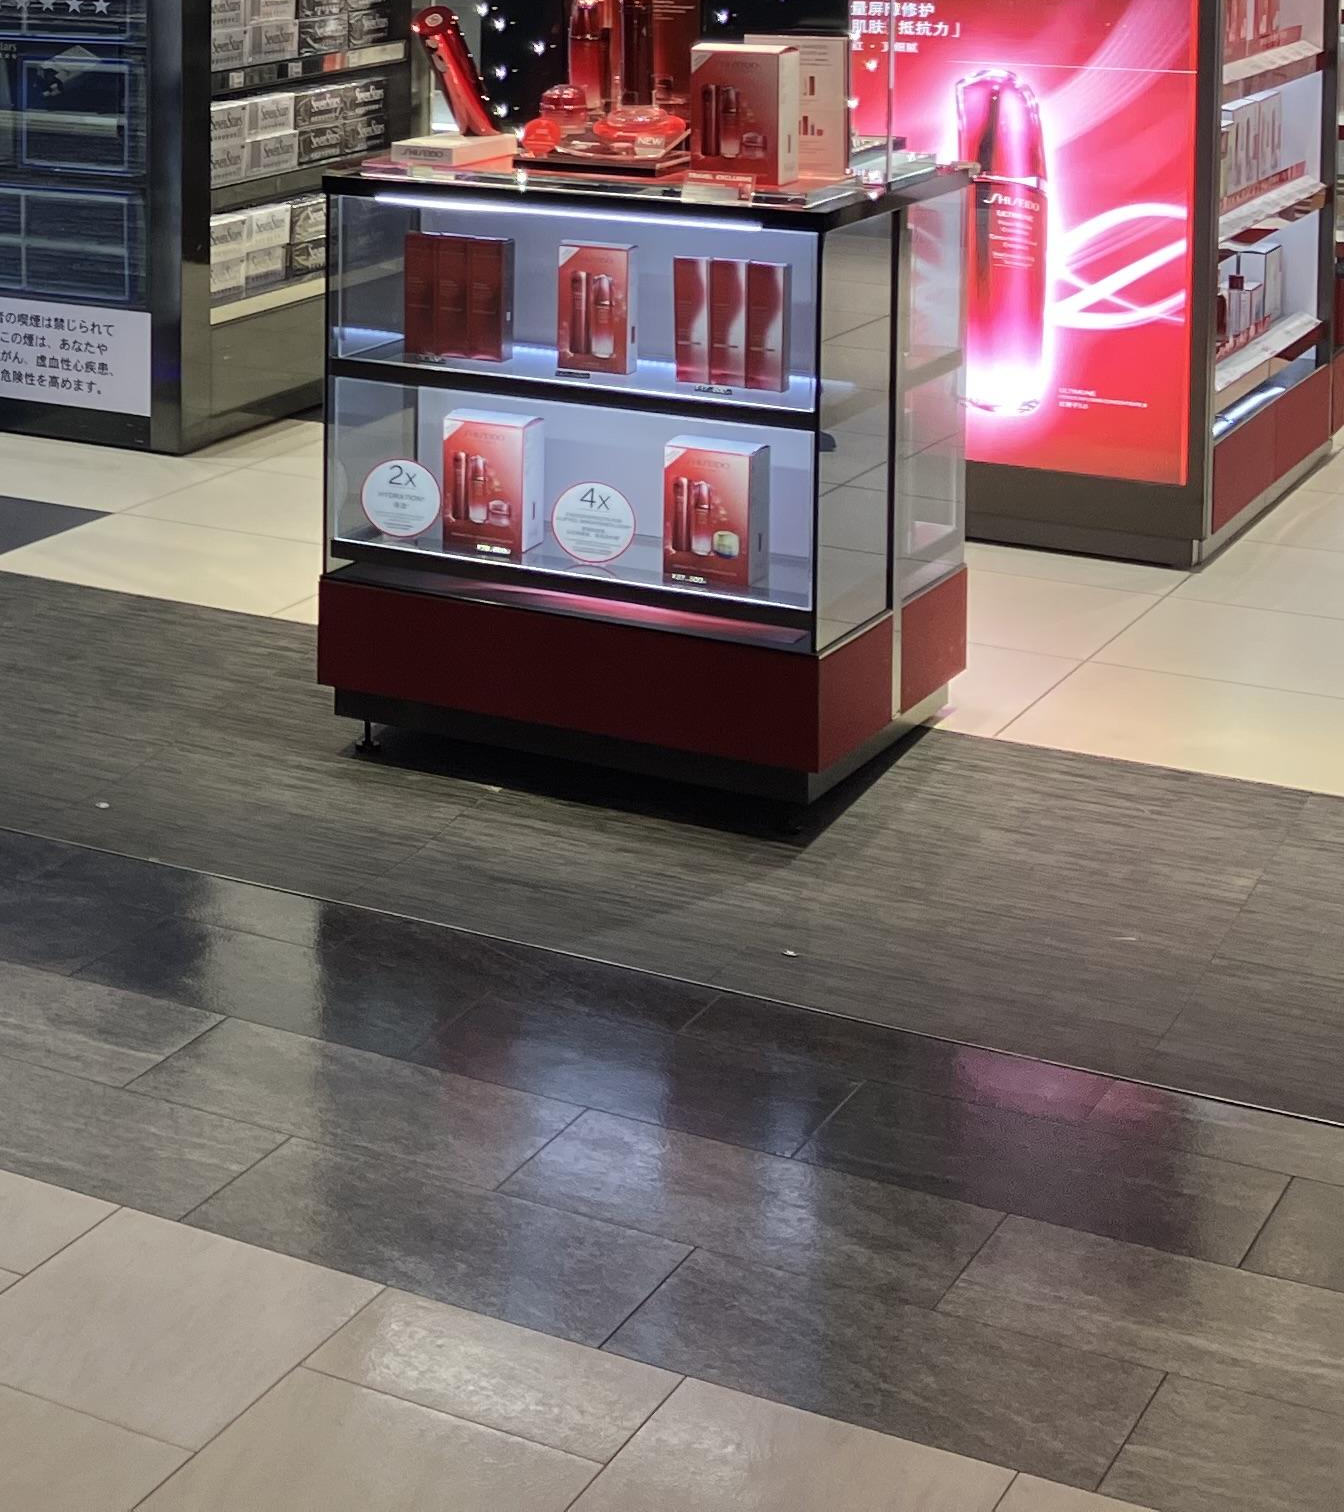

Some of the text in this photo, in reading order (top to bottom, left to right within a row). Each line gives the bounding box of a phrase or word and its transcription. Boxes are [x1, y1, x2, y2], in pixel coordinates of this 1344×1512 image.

[851, 19, 961, 38] 肌肤抵抗力」
[637, 137, 665, 146] NEW
[715, 174, 753, 183] EXCLUSIVE
[983, 193, 1040, 212] SHISEIDO
[388, 464, 417, 488] 2x
[579, 487, 611, 512] 4x
